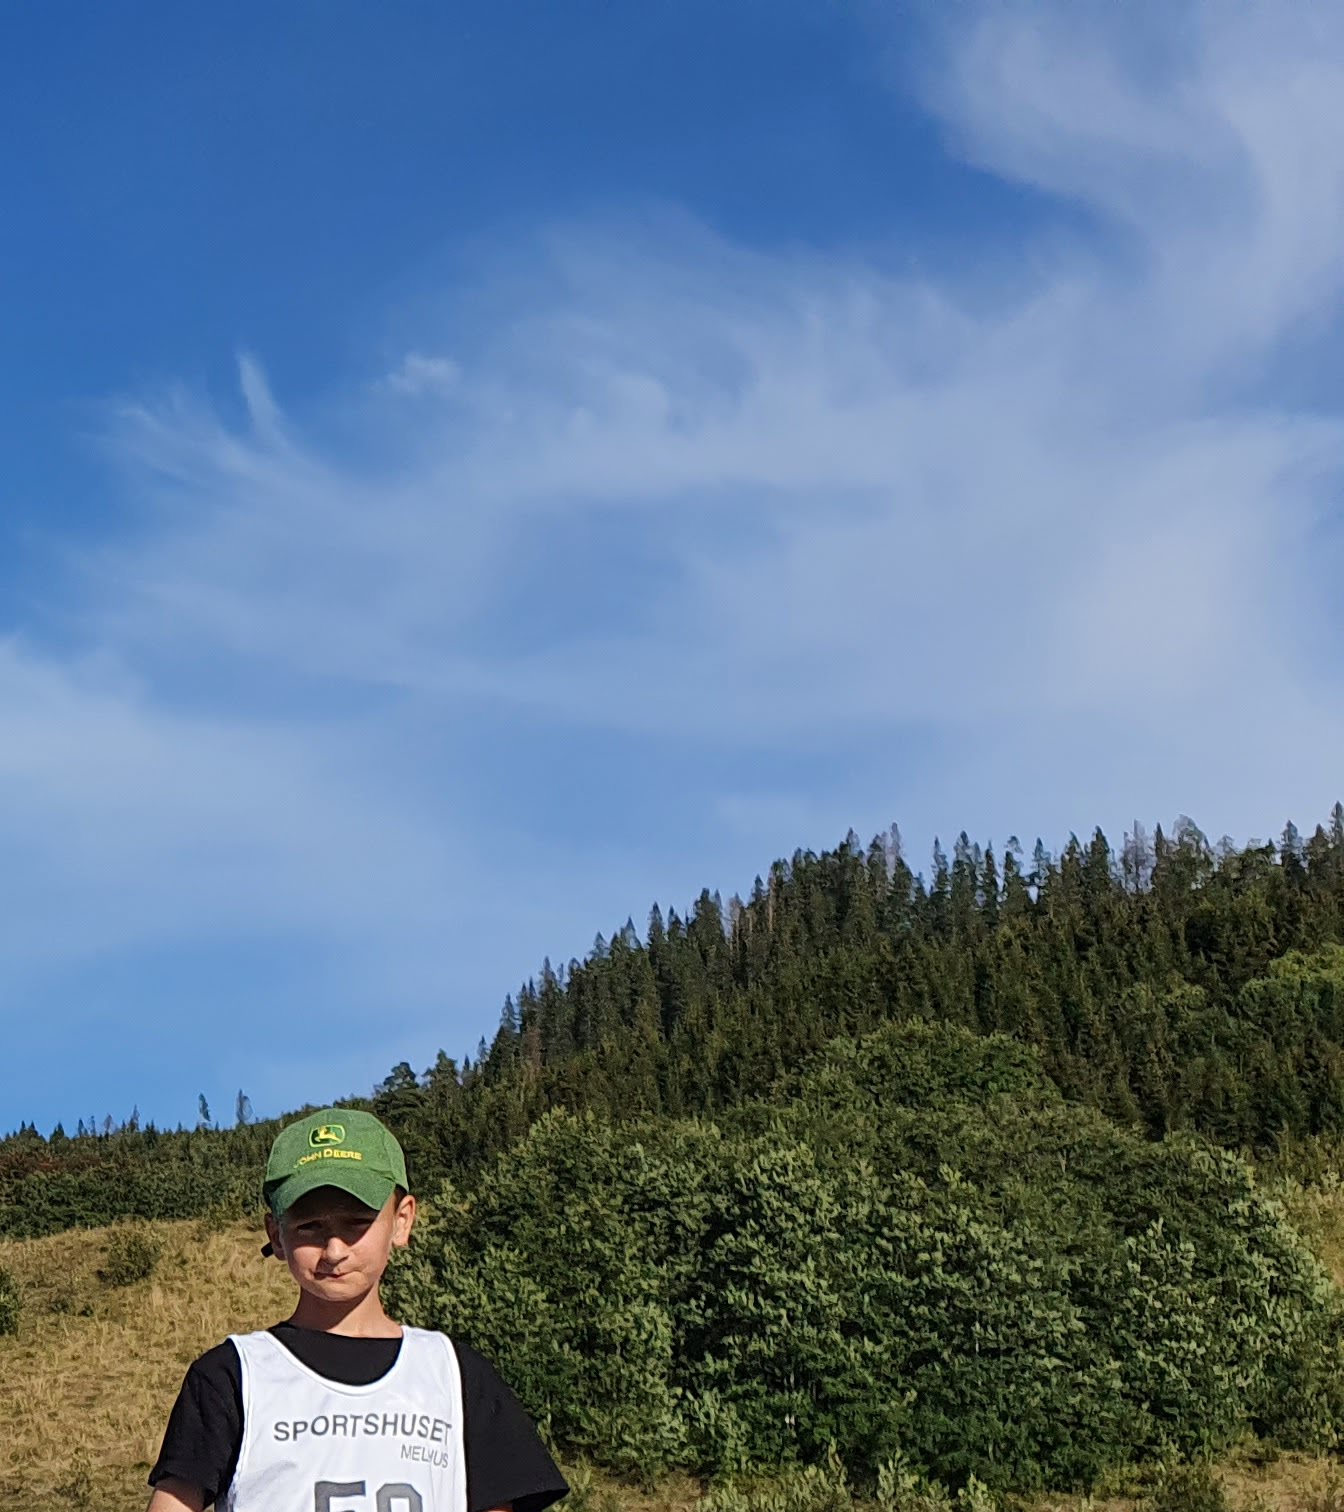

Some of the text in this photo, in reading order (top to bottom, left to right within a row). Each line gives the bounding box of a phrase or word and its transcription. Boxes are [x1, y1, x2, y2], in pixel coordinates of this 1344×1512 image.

[293, 1148, 363, 1169] JOHN DEERE
[273, 1412, 452, 1446] SPORTSHUSET
[401, 1444, 449, 1468] MELHUS
